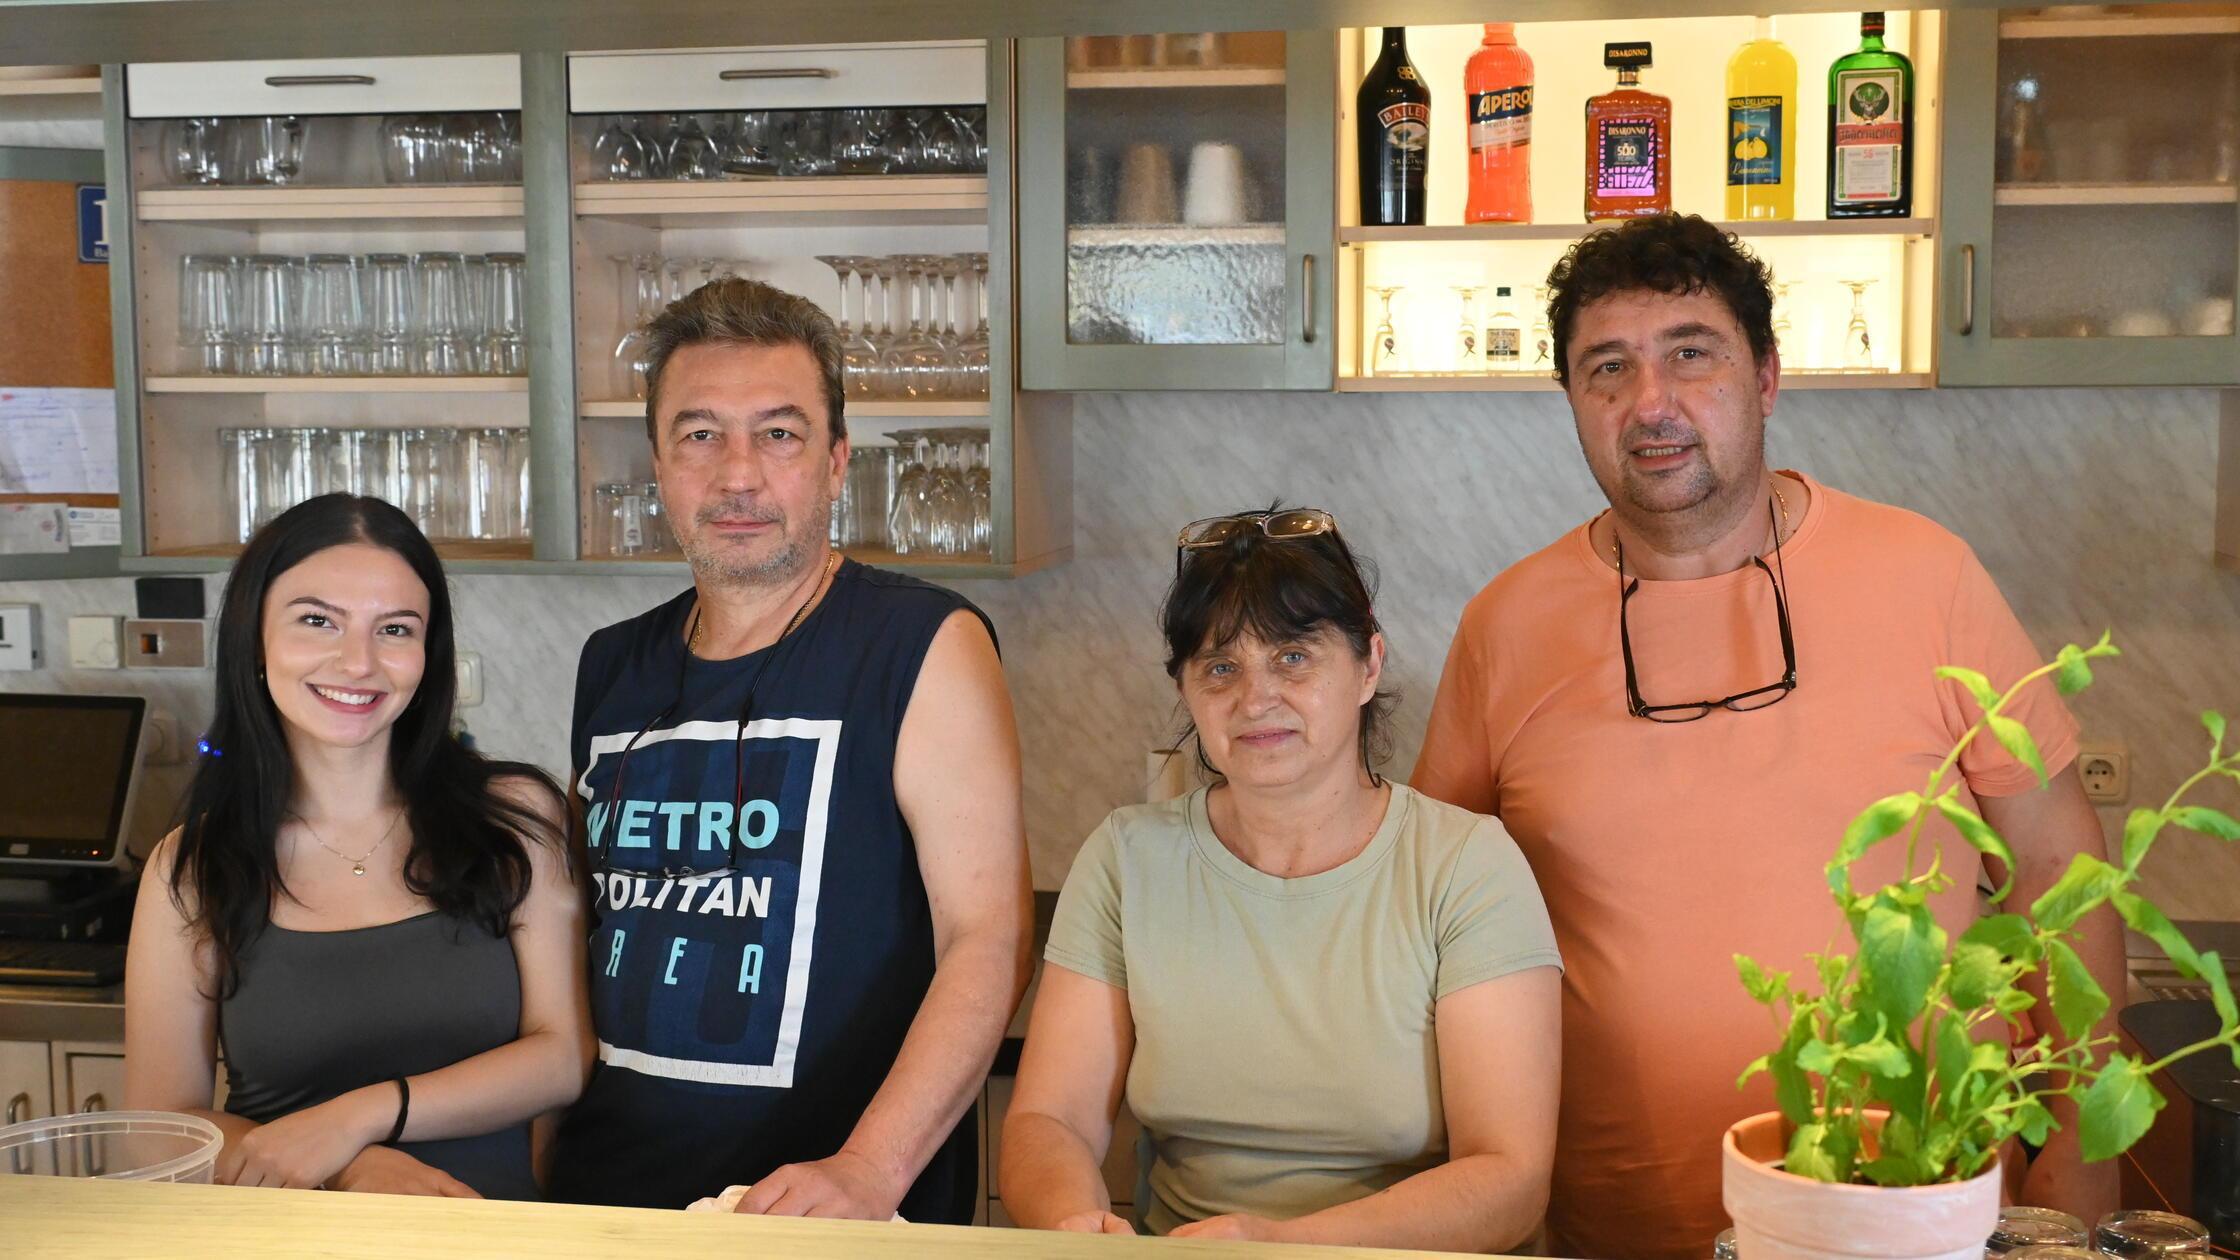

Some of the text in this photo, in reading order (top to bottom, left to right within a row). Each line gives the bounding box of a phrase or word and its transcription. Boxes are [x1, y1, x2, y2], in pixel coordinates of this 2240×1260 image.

[1609, 48, 1648, 57] DISARONNO
[1383, 104, 1430, 122] BAILEY
[1608, 126, 1646, 136] DISARONNO
[1617, 144, 1637, 156] 500
[586, 799, 780, 850] METRO
[590, 929, 764, 995] REA
